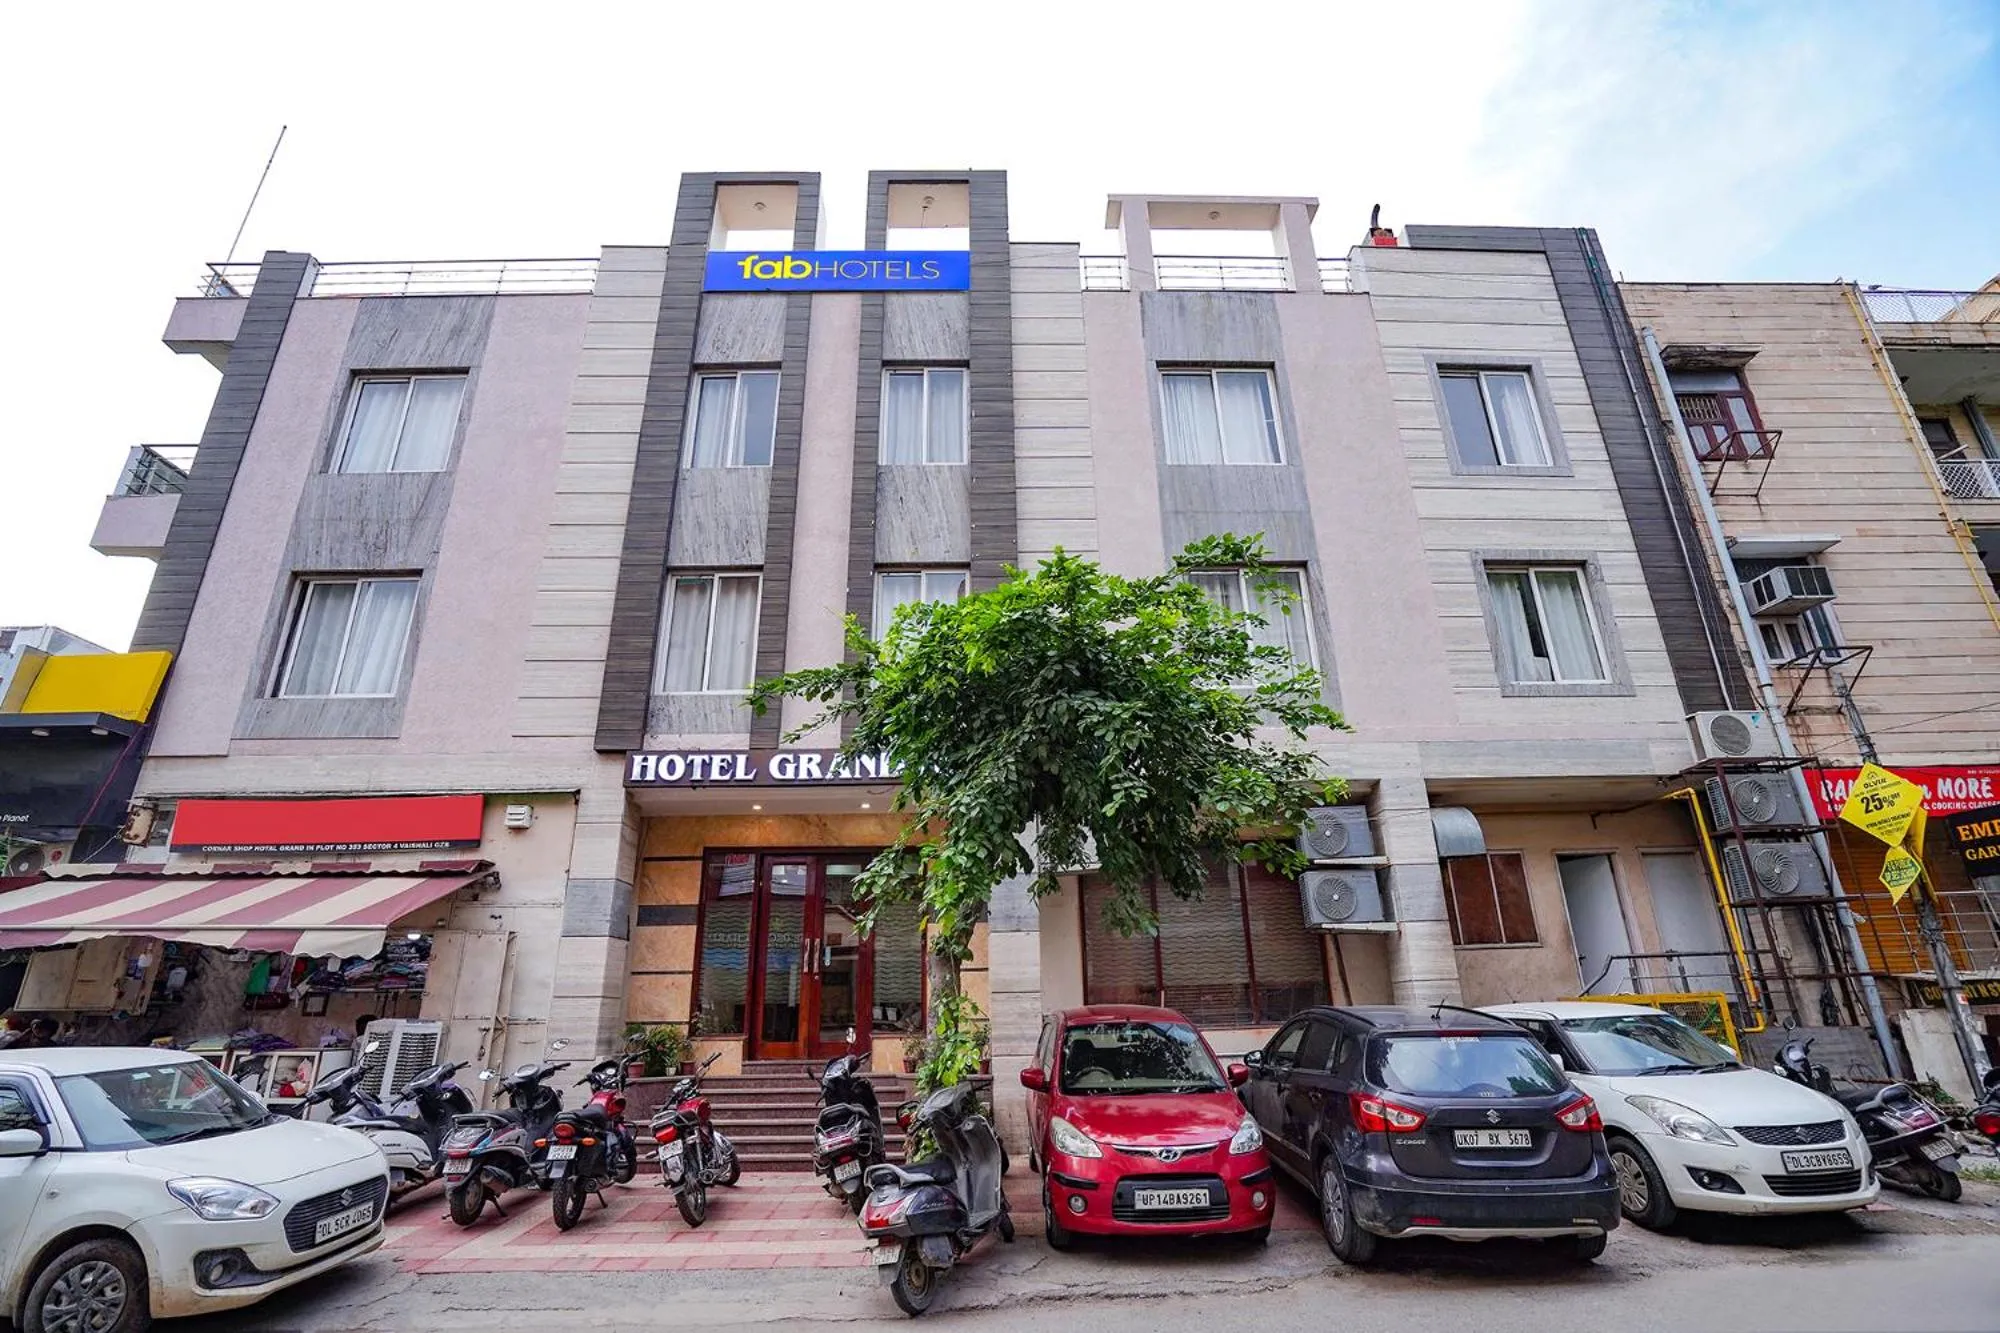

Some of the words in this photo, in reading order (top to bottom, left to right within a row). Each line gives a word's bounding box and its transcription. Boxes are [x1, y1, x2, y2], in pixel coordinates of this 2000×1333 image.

[630, 754, 756, 782] HOTEL
[1937, 776, 1994, 800] MORE
[1931, 801, 1967, 810] COOKING
[2, 814, 30, 823] Planet
[1965, 844, 2000, 861] GAR
[1456, 1133, 1479, 1146] UK07
[1488, 1132, 1501, 1145] BX
[1508, 1131, 1530, 1146] 5678
[1141, 1191, 1208, 1207] UP14BA9261
